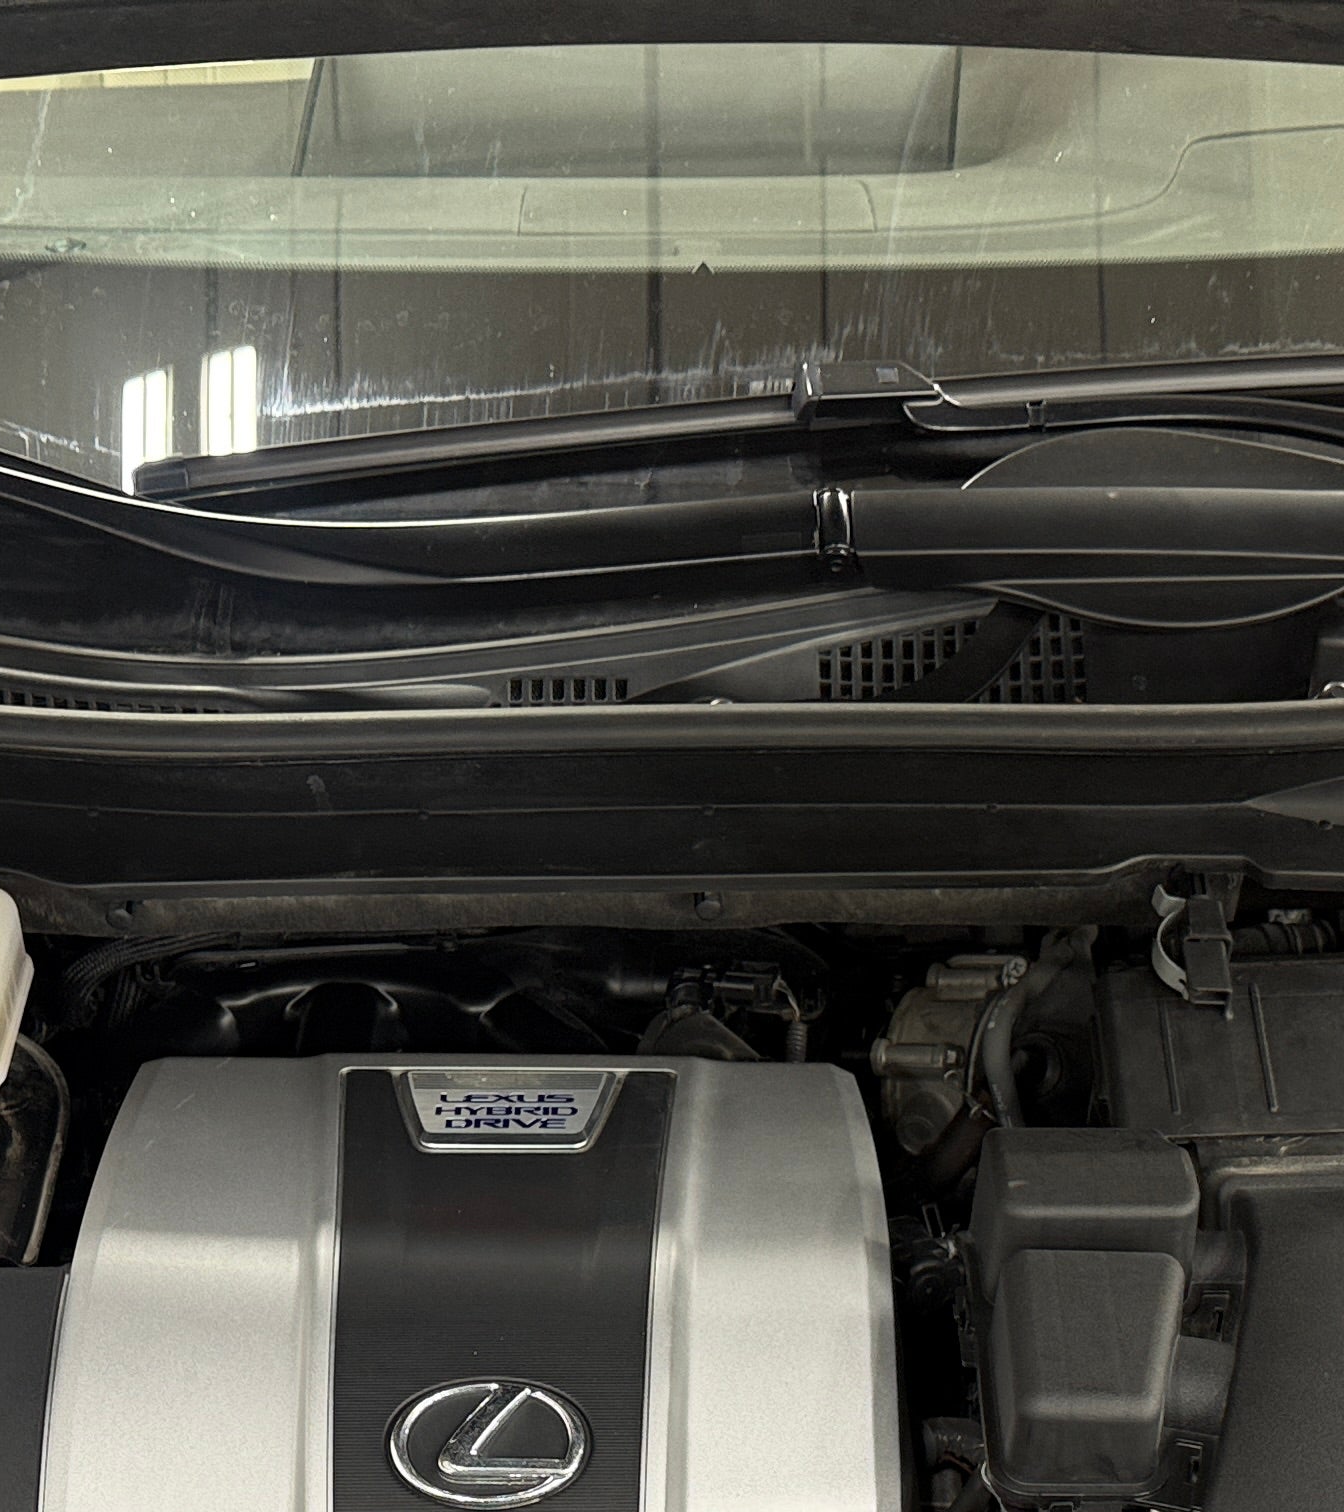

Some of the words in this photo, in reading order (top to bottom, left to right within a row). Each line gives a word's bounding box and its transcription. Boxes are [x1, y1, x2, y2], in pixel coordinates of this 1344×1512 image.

[440, 1093, 575, 1104] LEXUS
[435, 1106, 579, 1116] HYBRID
[444, 1118, 567, 1129] DRIVE
